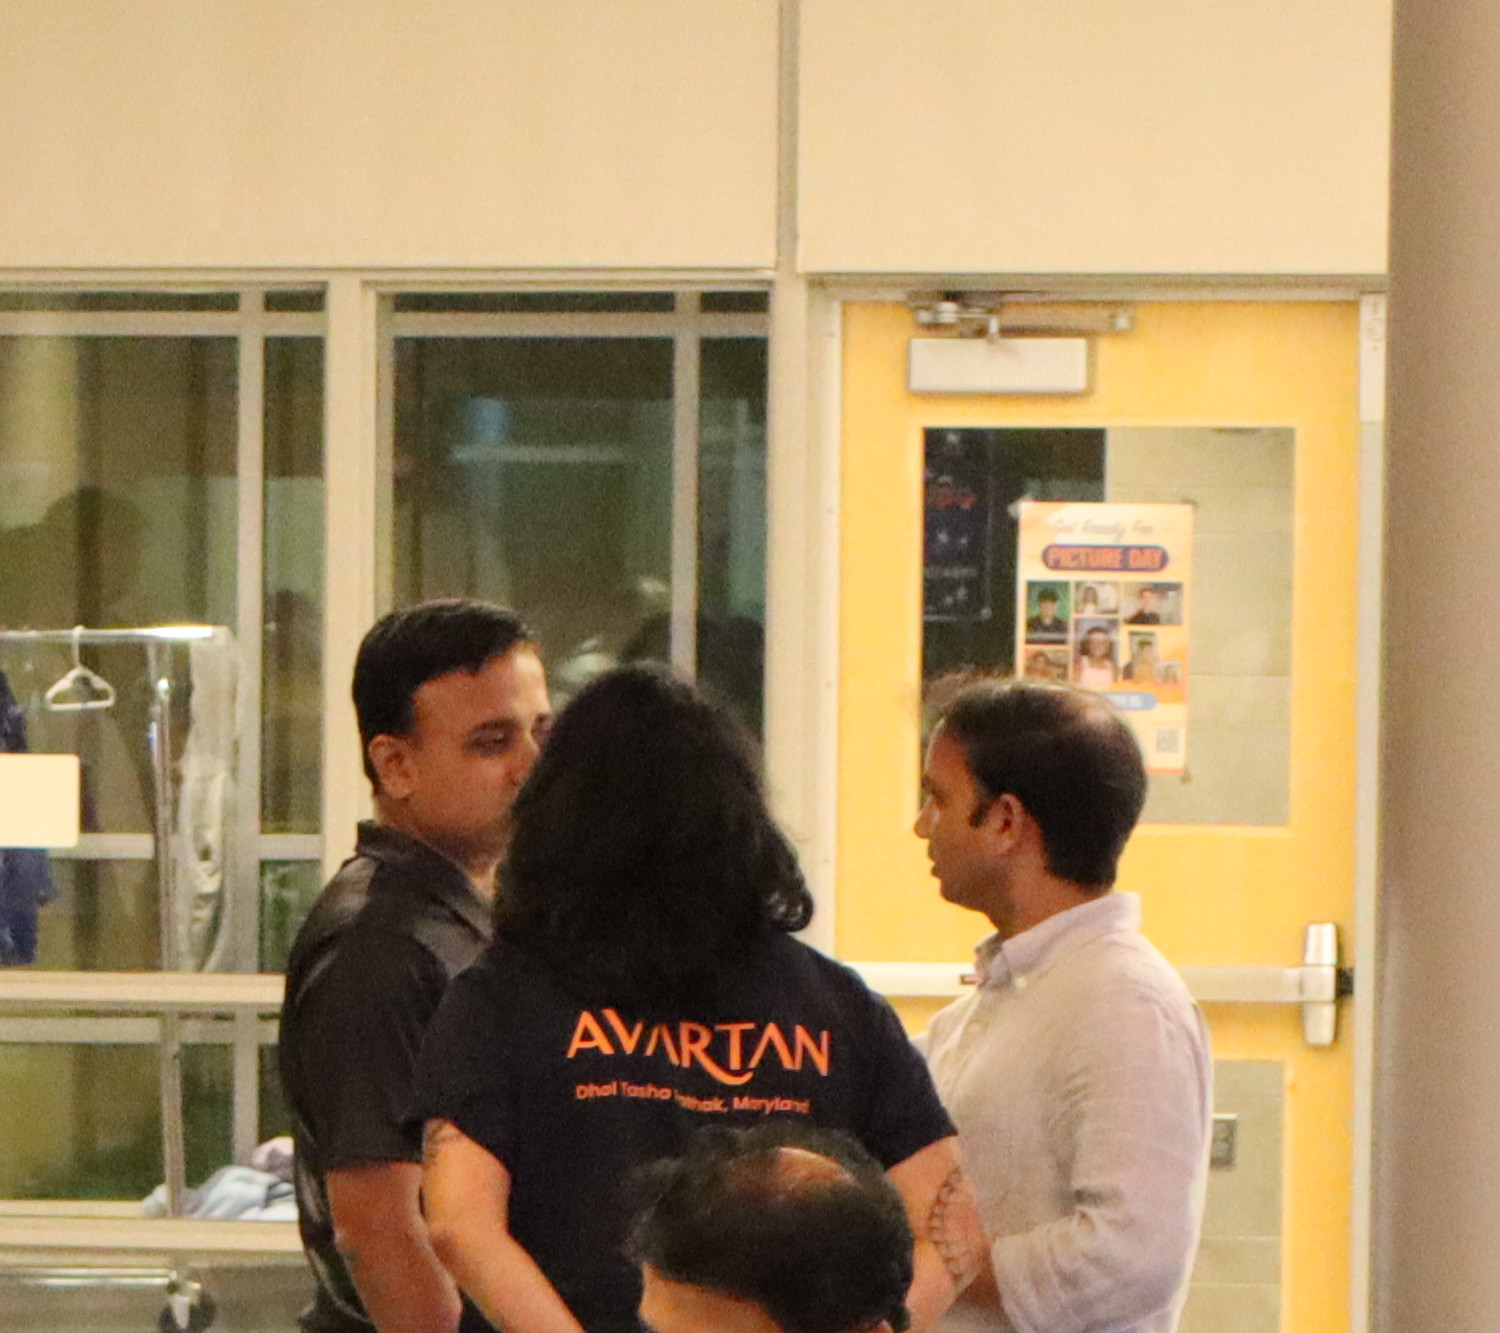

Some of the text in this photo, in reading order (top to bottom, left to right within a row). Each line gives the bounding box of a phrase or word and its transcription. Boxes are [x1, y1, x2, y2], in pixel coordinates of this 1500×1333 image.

[1047, 547, 1164, 569] PICTURE DAY
[566, 1008, 831, 1086] AVARTAN
